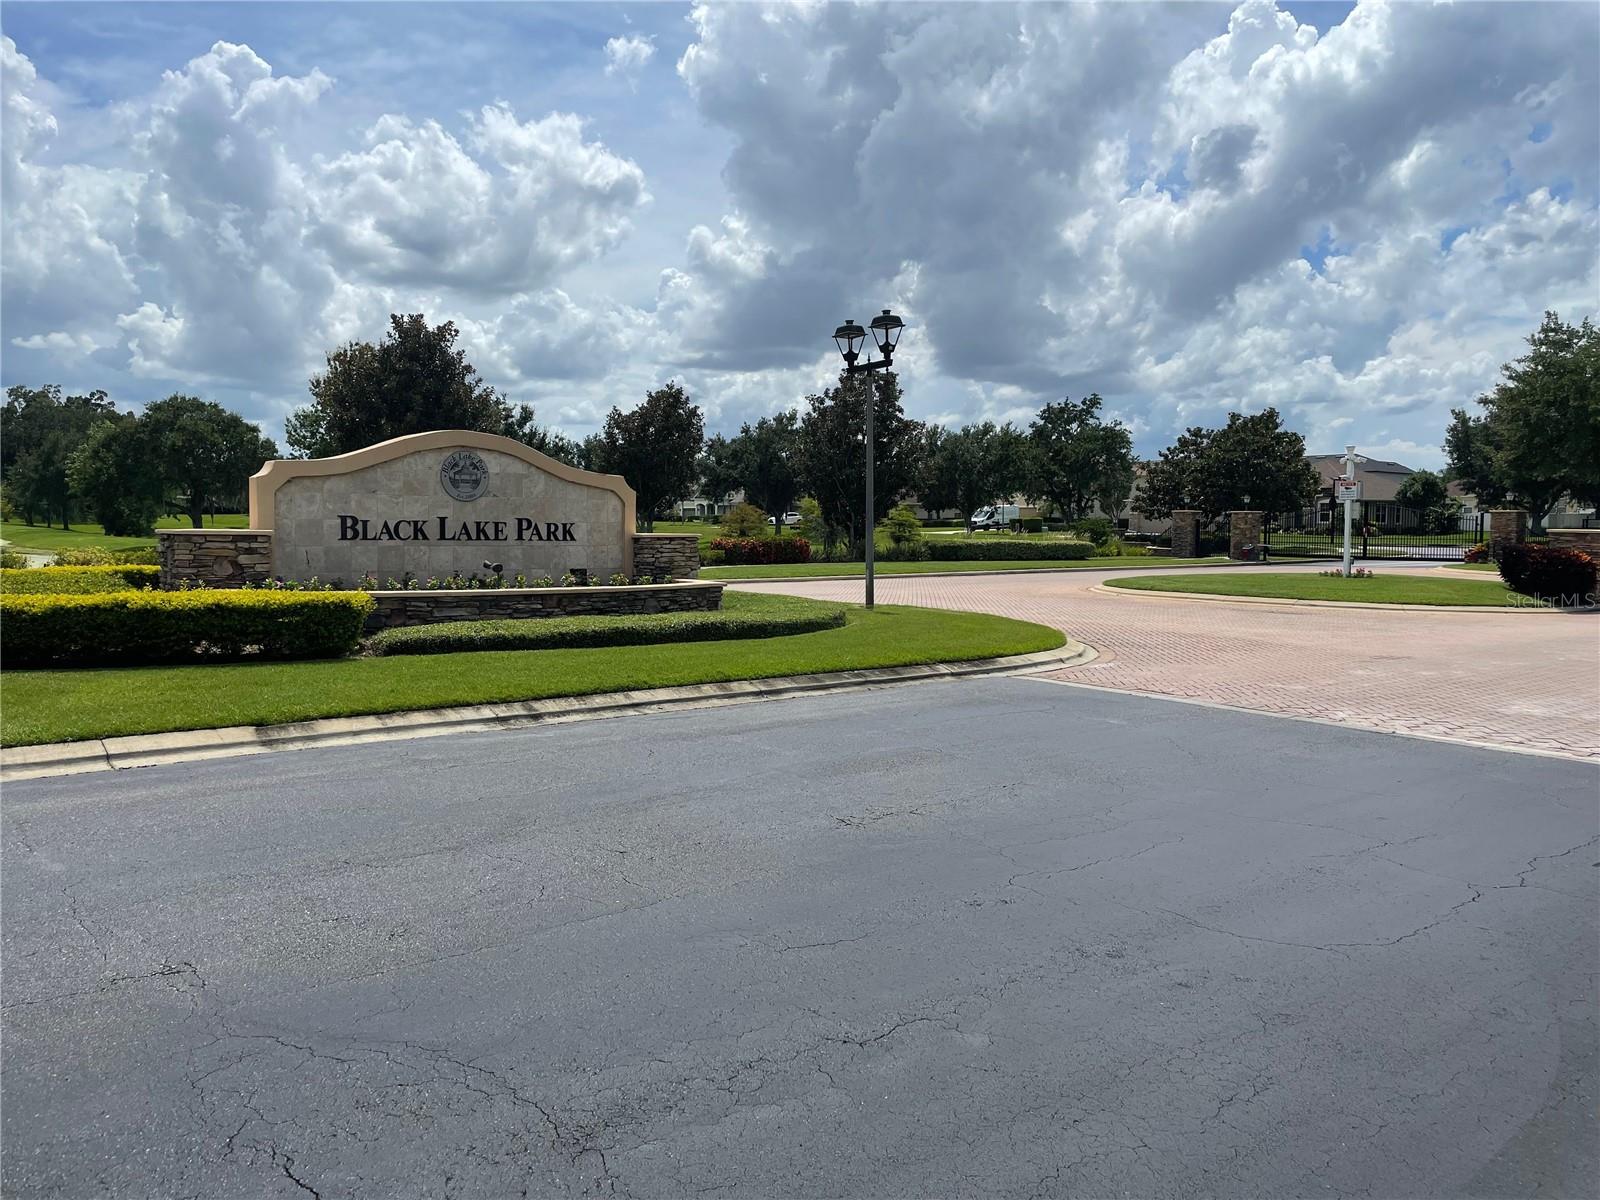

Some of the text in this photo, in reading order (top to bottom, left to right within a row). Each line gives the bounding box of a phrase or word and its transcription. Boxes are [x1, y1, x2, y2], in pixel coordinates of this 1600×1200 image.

[337, 515, 577, 542] BLACK LAKE PARK
